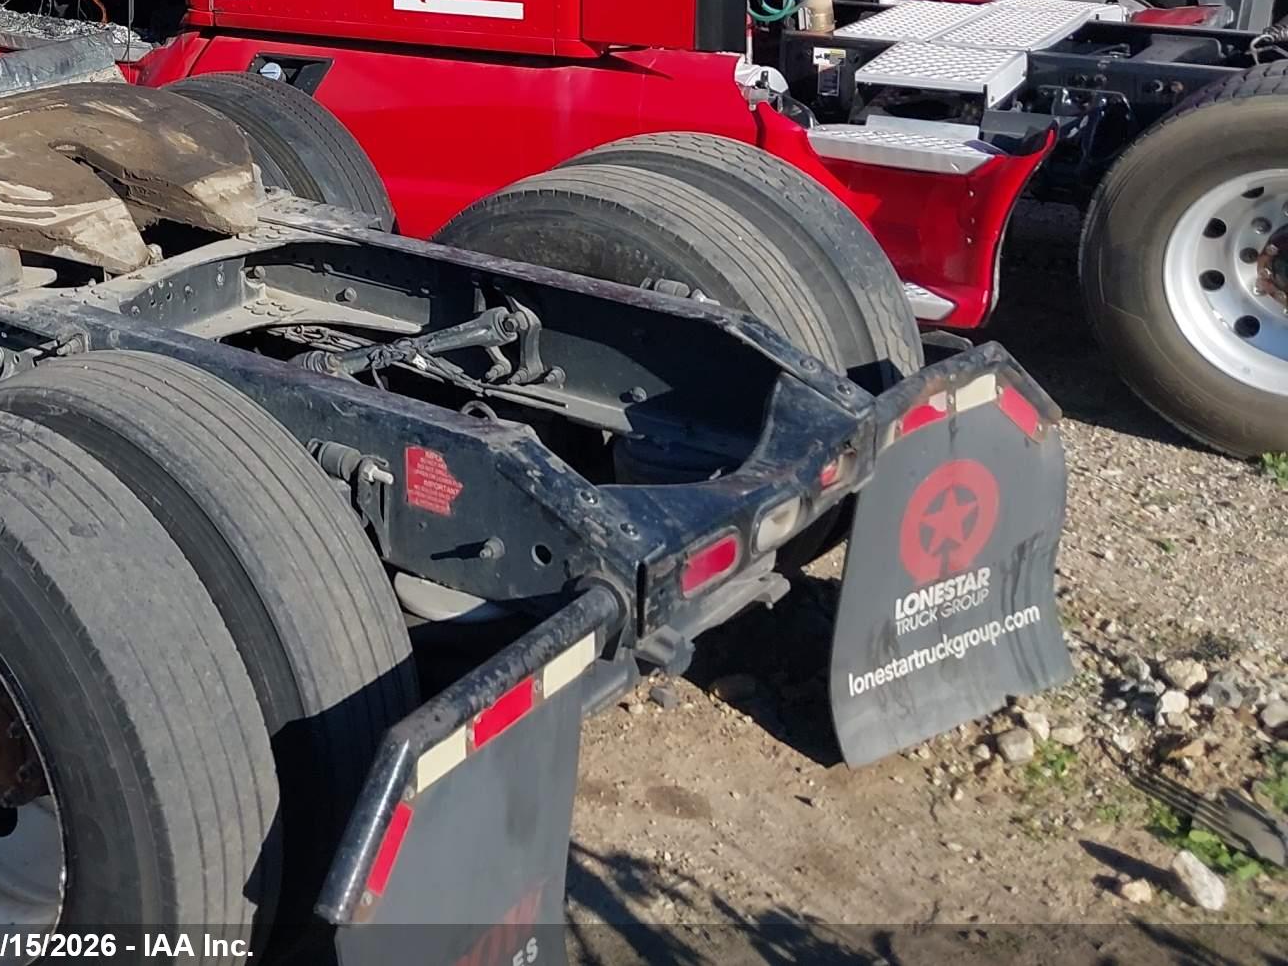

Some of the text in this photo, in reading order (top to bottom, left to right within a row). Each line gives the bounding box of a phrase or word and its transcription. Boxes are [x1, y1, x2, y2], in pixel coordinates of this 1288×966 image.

[895, 567, 992, 620] LONESTAR
[896, 587, 991, 637] TRUCK GROUP
[848, 604, 1041, 697] lonestartruckgroup.com
